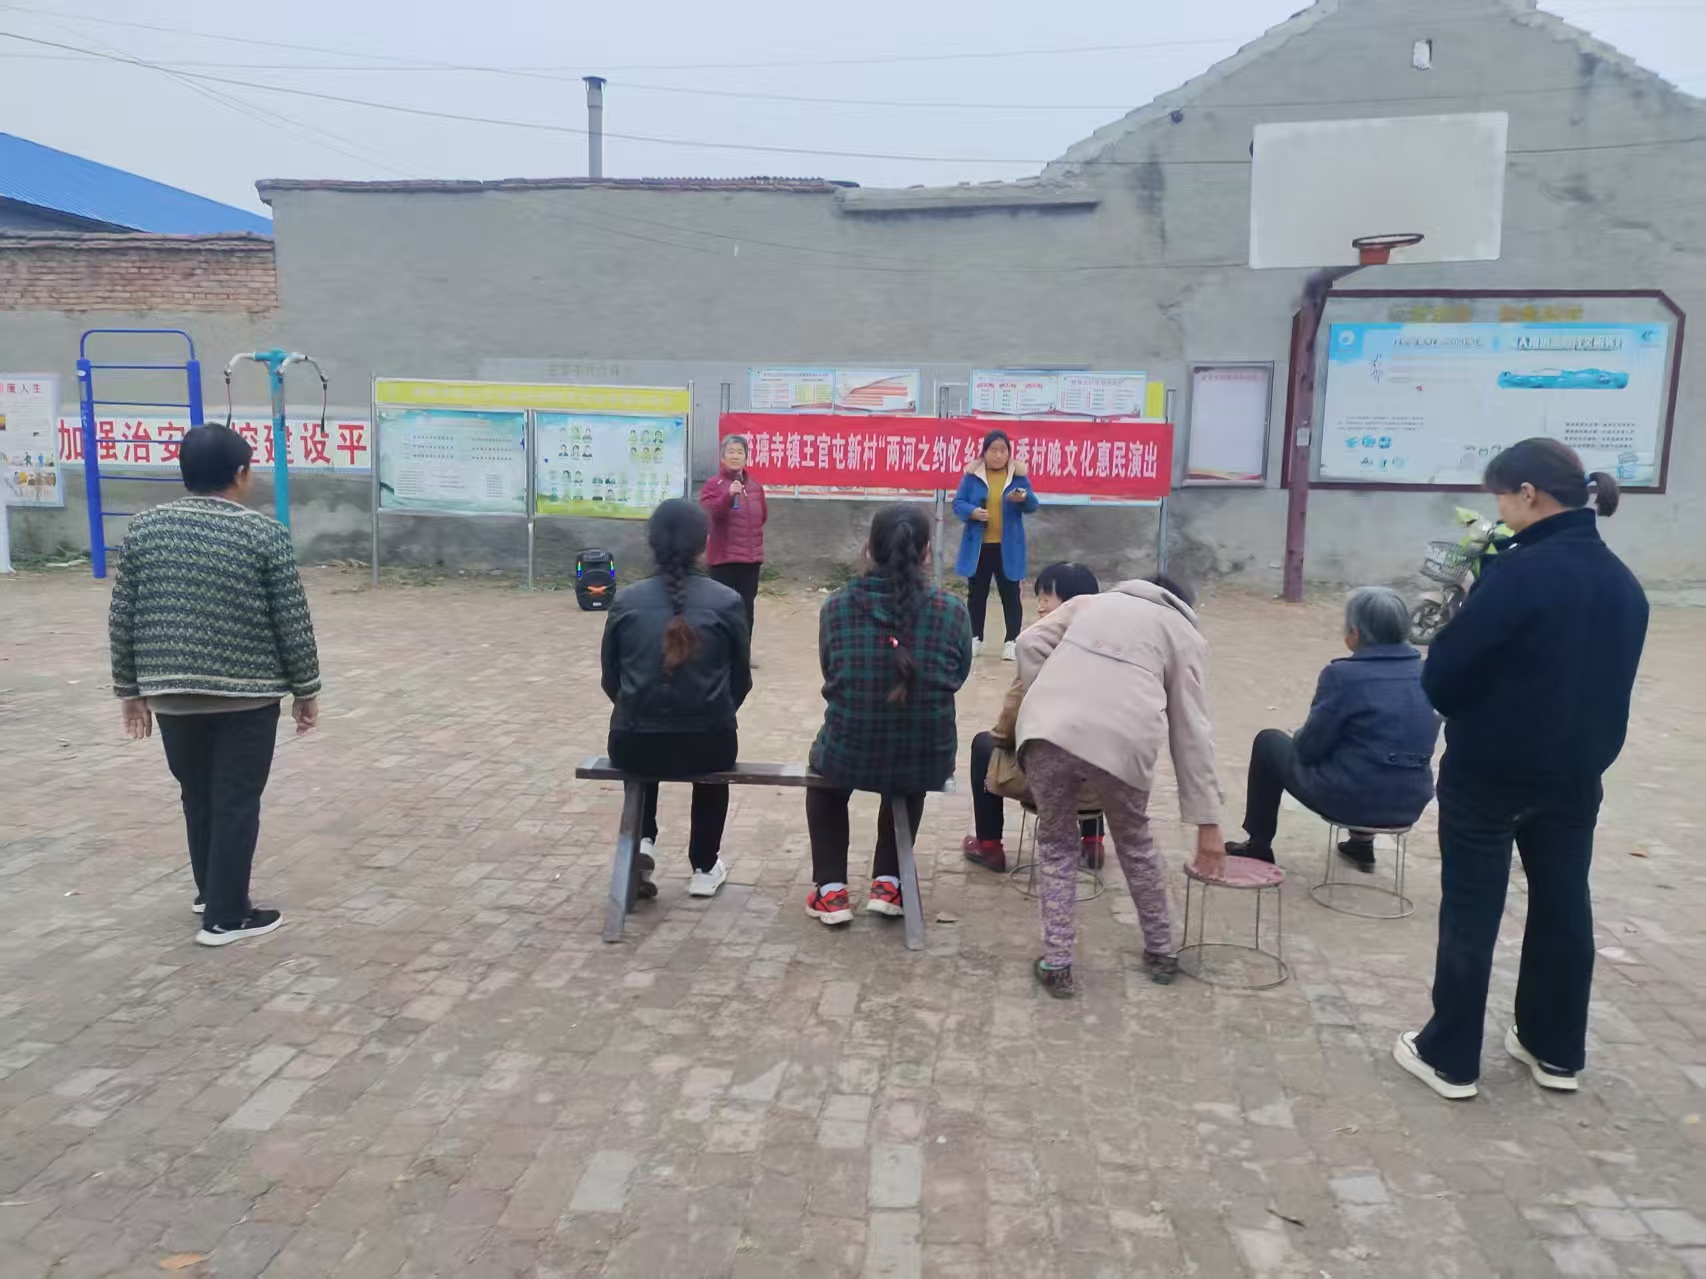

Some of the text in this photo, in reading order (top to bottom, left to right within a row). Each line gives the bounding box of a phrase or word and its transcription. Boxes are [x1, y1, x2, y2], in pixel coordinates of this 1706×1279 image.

[58, 419, 368, 464] 加强治安控建设平
